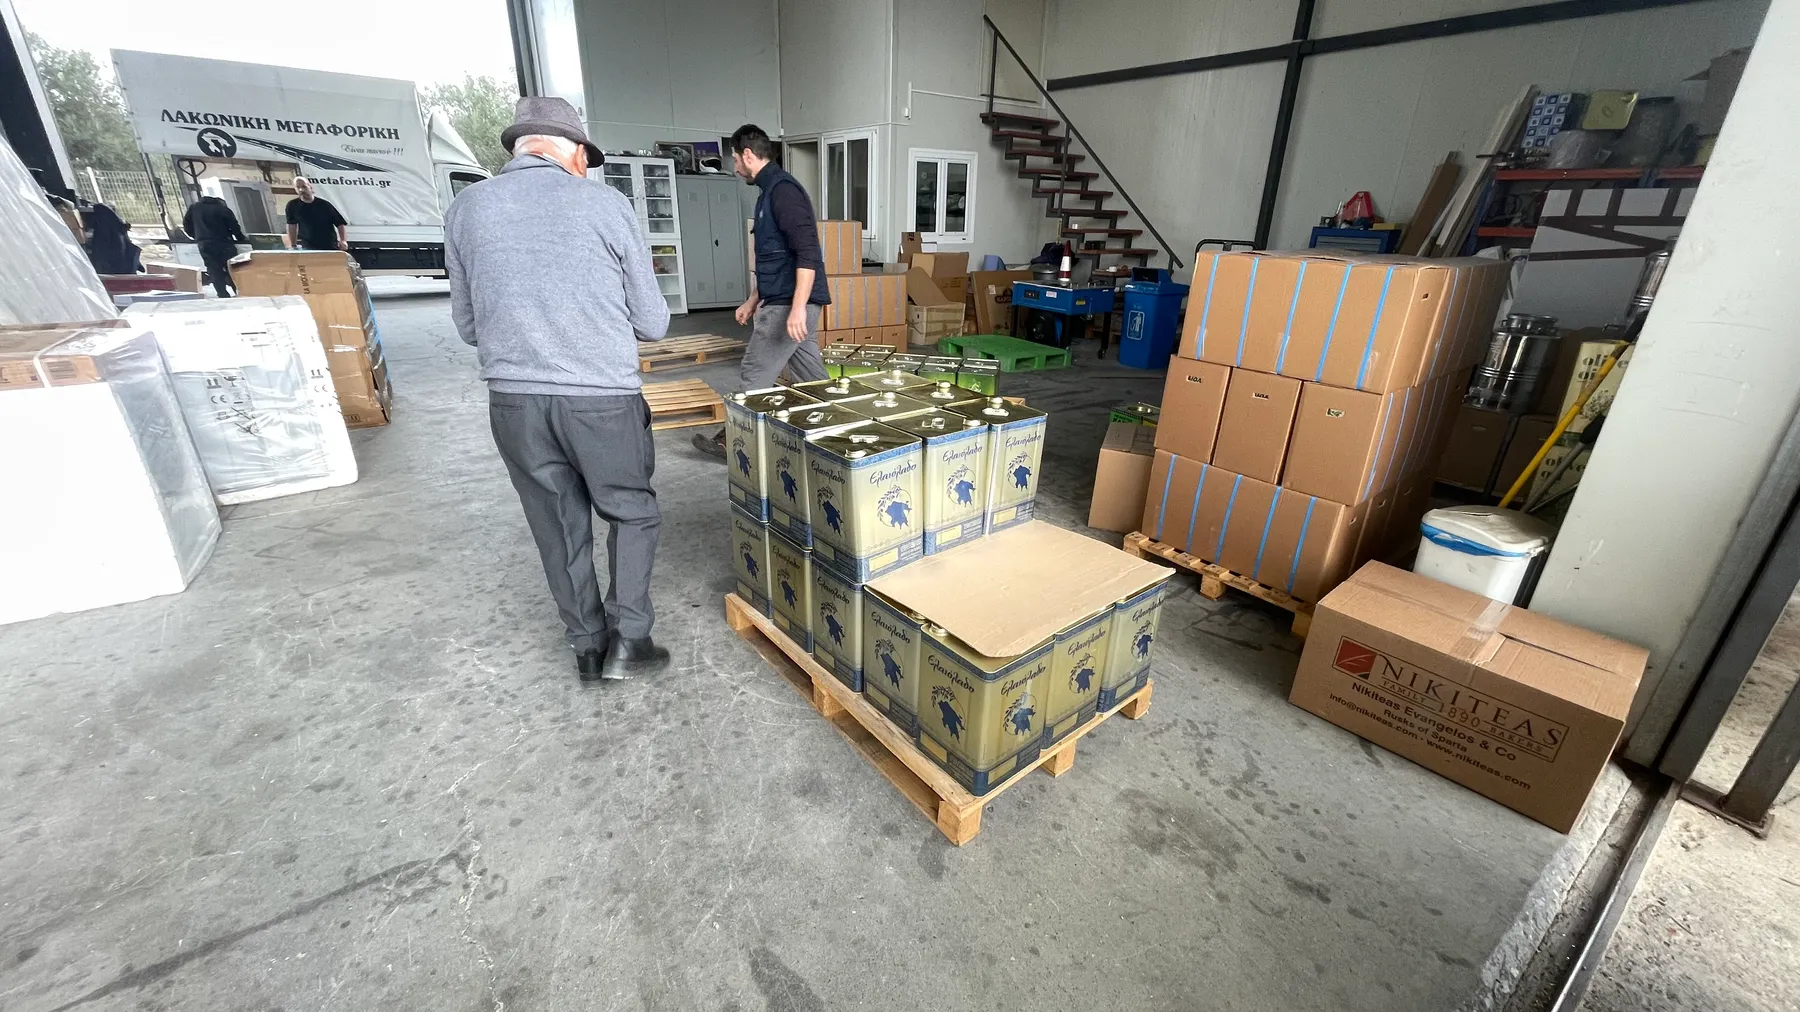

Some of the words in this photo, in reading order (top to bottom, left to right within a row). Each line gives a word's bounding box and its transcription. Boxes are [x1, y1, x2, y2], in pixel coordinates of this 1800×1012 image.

[161, 109, 271, 131] ΛΑΚΩΝΙΚΗ
[275, 119, 400, 140] ΜΕΤΑΦΟΡΙΚΗ
[307, 174, 392, 188] metaforiki.gr
[1351, 682, 1401, 711] Nikiteas
[1404, 706, 1475, 744] Evangelos
[1479, 740, 1490, 751] &
[1495, 746, 1517, 761] Co
[1376, 653, 1562, 747] NIKITEAS
[1383, 680, 1426, 703] FAMILY
[1438, 702, 1482, 729] 1890
[1489, 727, 1543, 752] BAKERS
[1383, 709, 1415, 728] Rusks
[1417, 726, 1429, 735] of
[1431, 731, 1468, 752] Sparta
[1426, 739, 1532, 791] www.nikiteas.com
